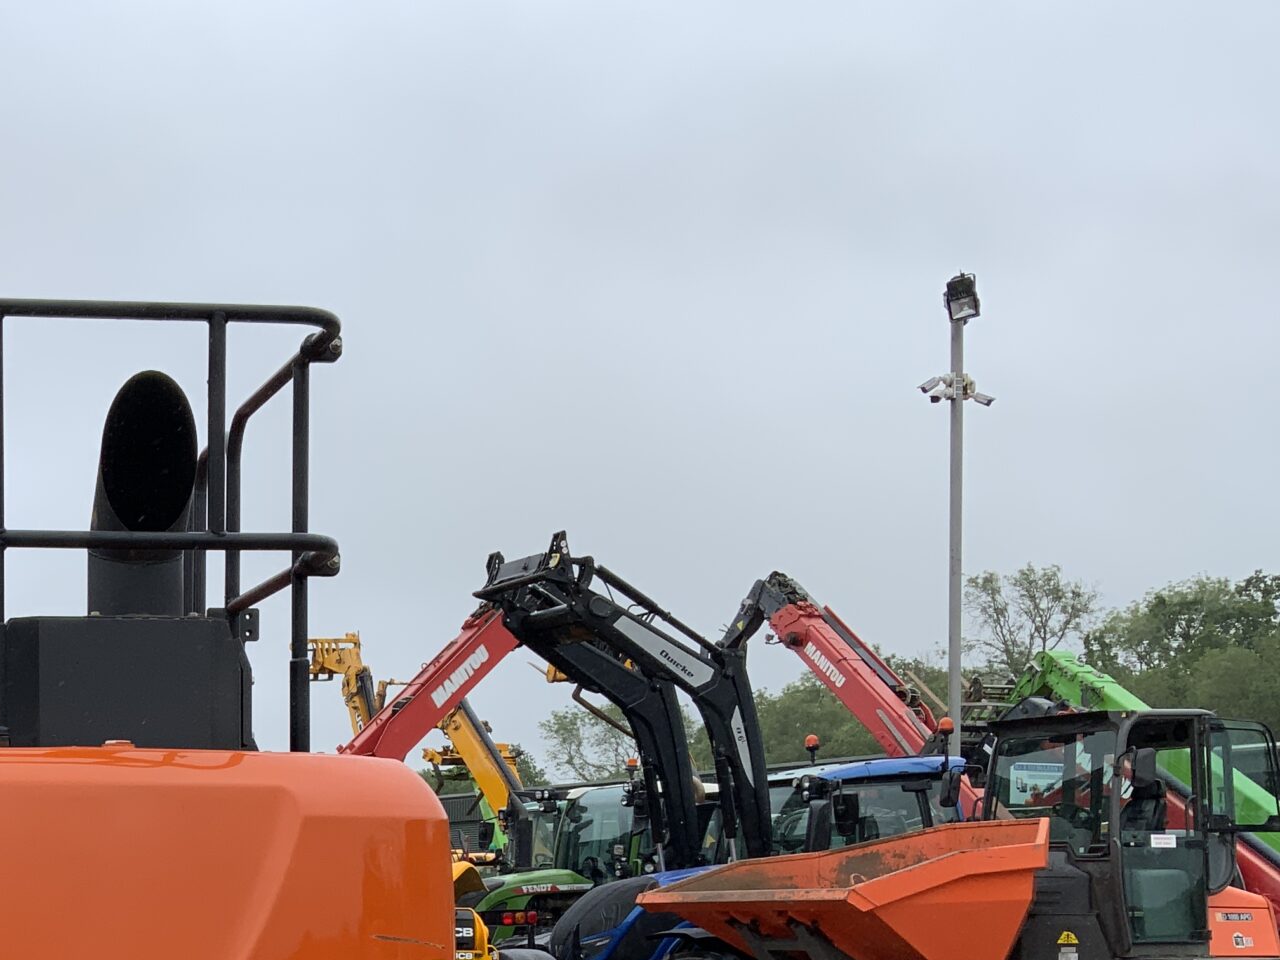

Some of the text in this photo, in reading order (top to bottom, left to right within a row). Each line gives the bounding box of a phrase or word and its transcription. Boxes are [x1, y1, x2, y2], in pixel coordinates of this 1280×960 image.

[431, 644, 489, 708] MANITOU
[660, 649, 695, 678] Quicke
[804, 641, 846, 687] MANITOU
[522, 884, 553, 893] FENDT
[455, 927, 474, 937] CB
